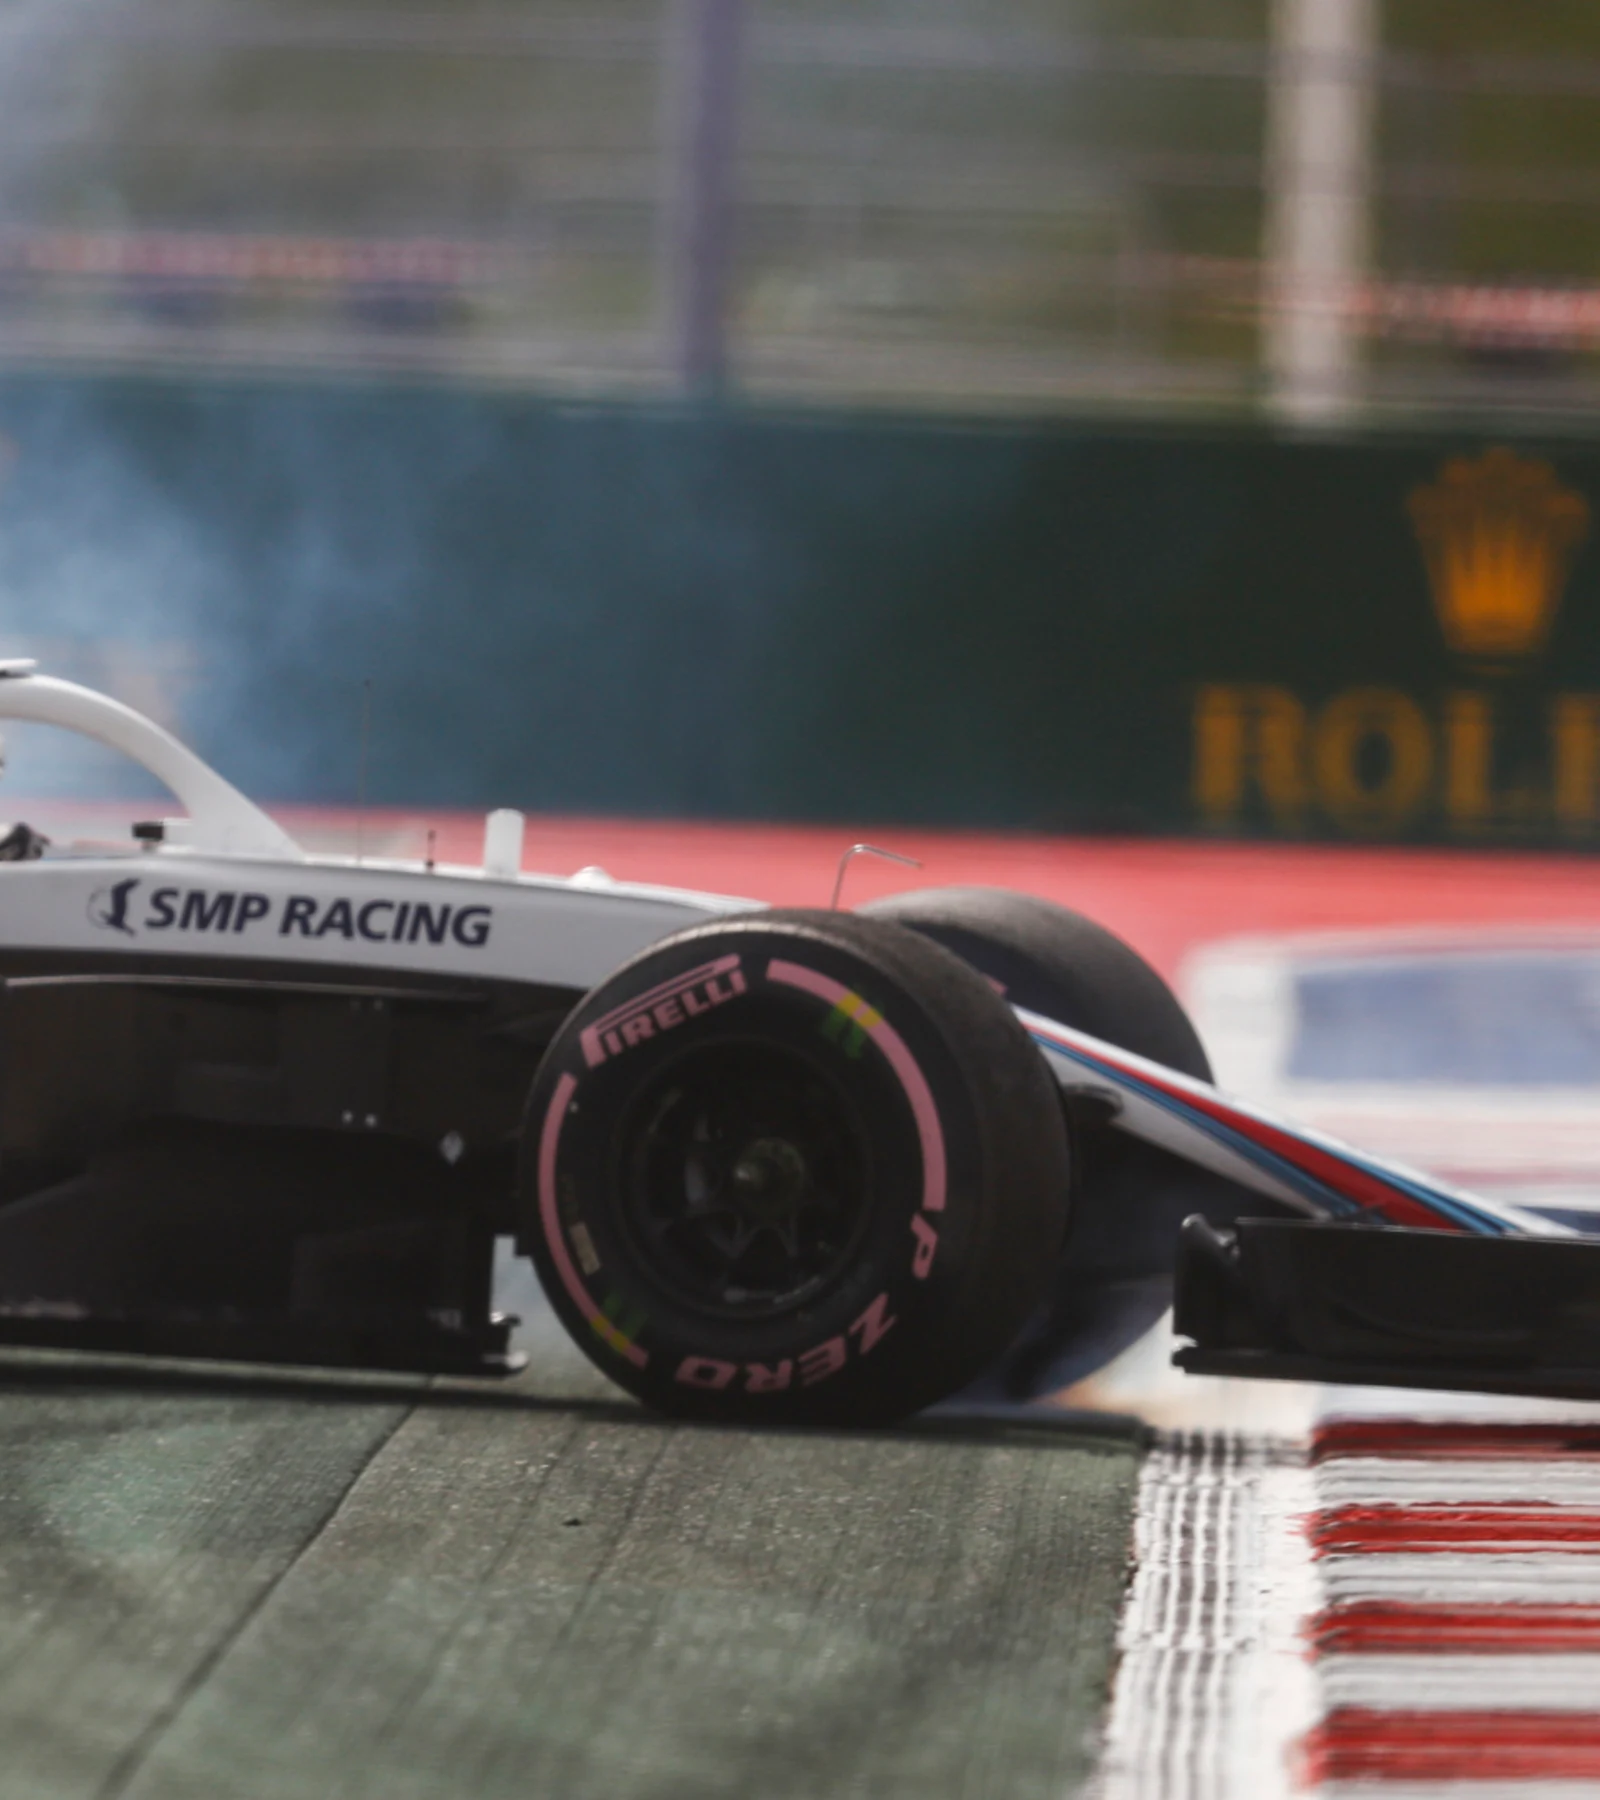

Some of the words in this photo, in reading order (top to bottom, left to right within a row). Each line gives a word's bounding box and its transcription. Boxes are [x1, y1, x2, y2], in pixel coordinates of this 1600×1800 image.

[145, 886, 269, 934] SMP
[279, 895, 492, 948] RACING
[580, 953, 747, 1069] PIRELLI
[910, 1213, 938, 1280] P
[674, 1292, 897, 1393] ZERO
